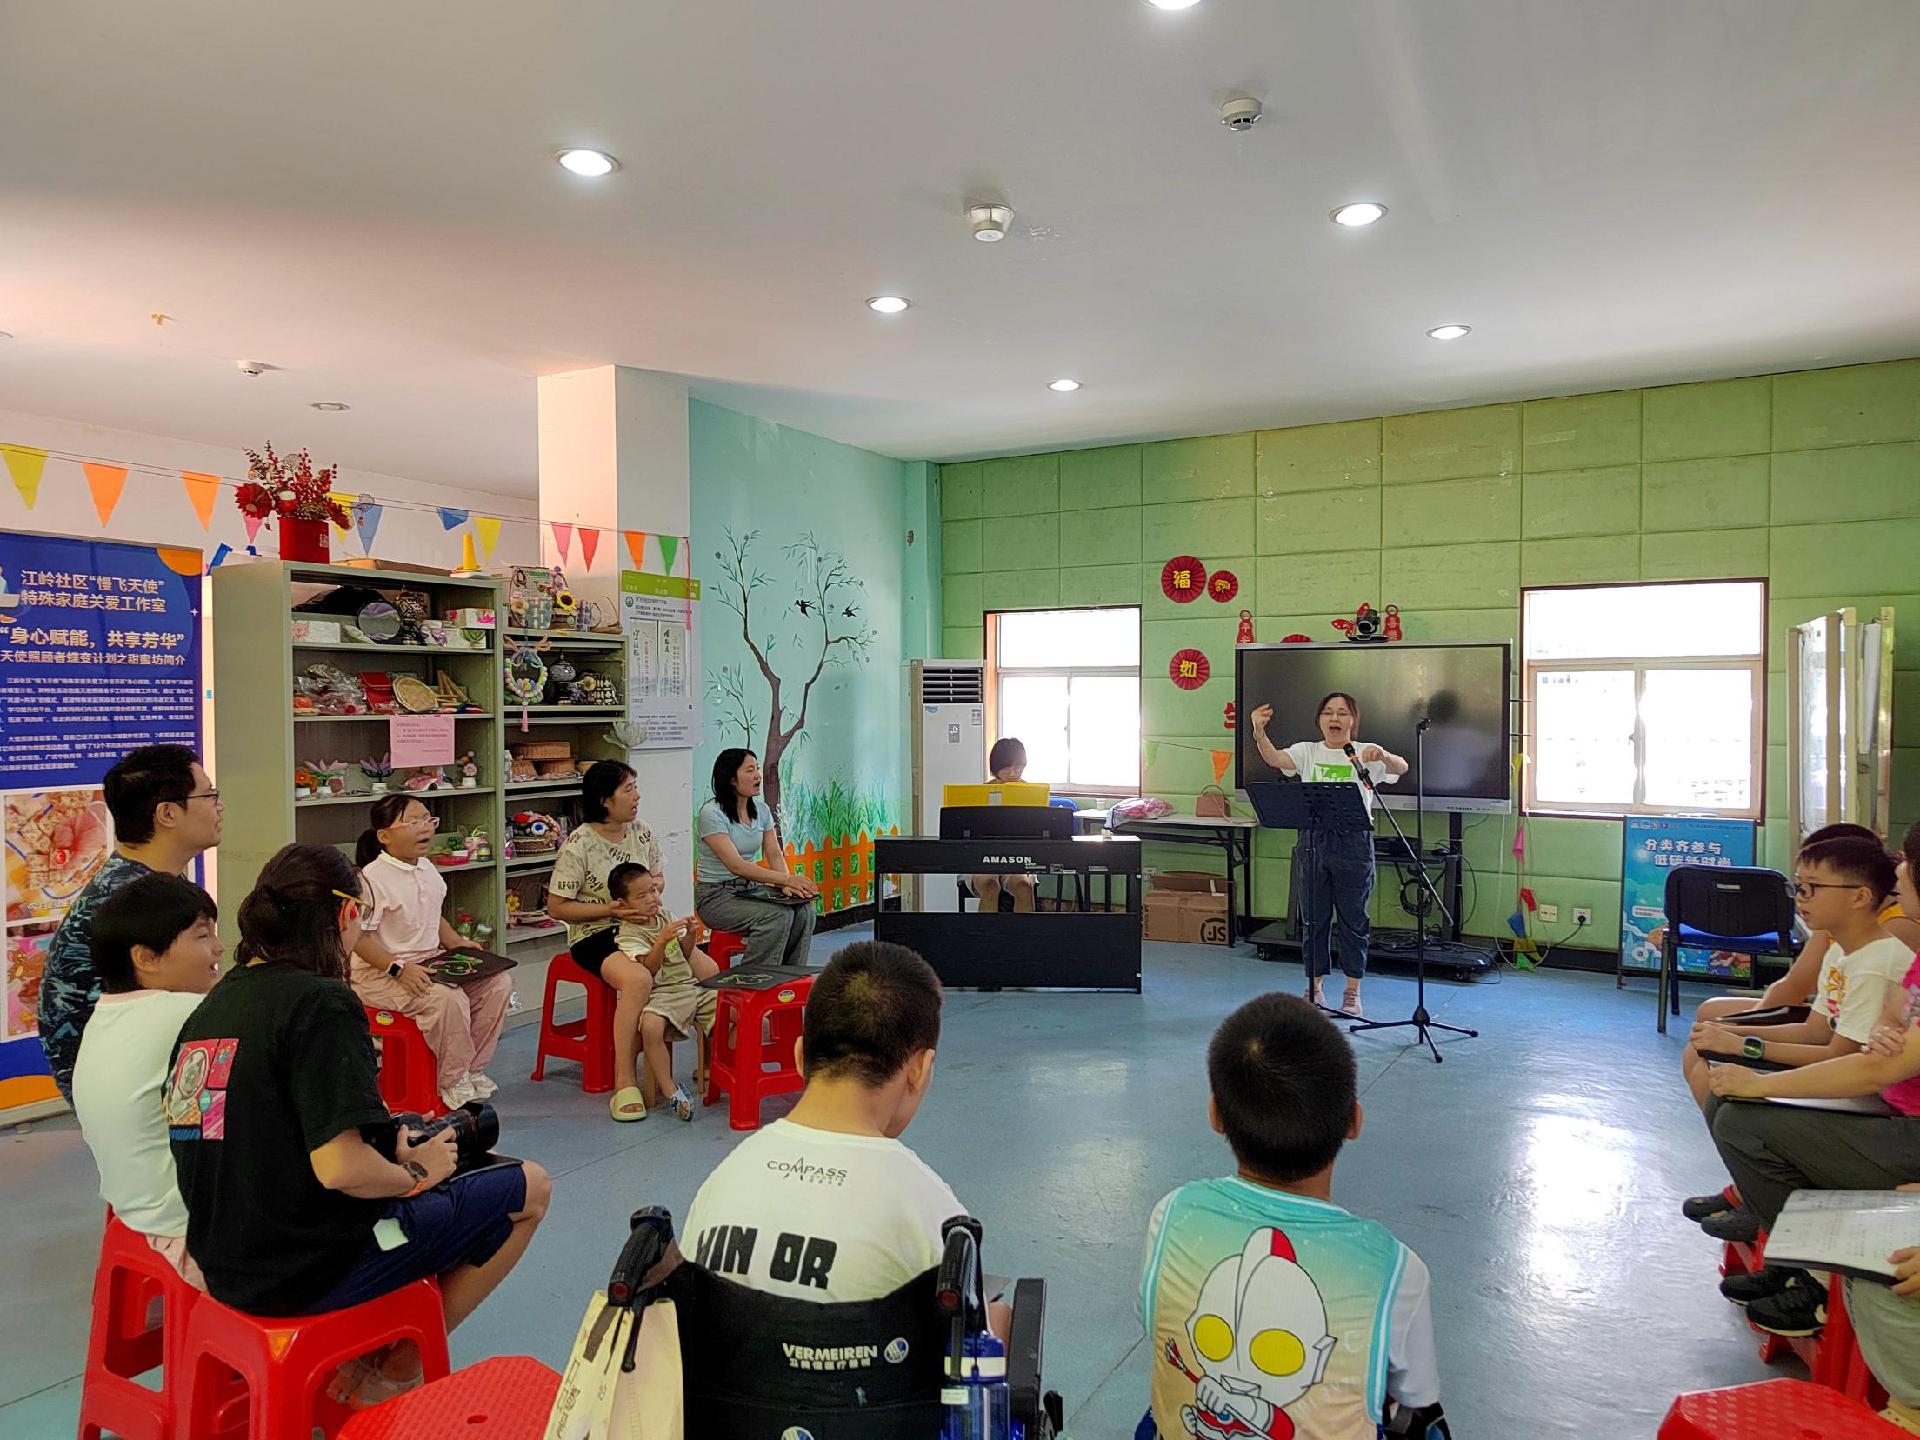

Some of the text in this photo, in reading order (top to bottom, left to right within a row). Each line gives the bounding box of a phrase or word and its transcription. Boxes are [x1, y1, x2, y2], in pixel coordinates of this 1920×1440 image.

[1173, 570, 1191, 589] 福
[21, 589, 167, 613] 特殊家庭关爱工作室
[982, 856, 1032, 864] AMASON
[766, 1157, 848, 1180] COMPASS
[769, 1232, 838, 1290] OR
[782, 1342, 878, 1361] VERMEIREN
